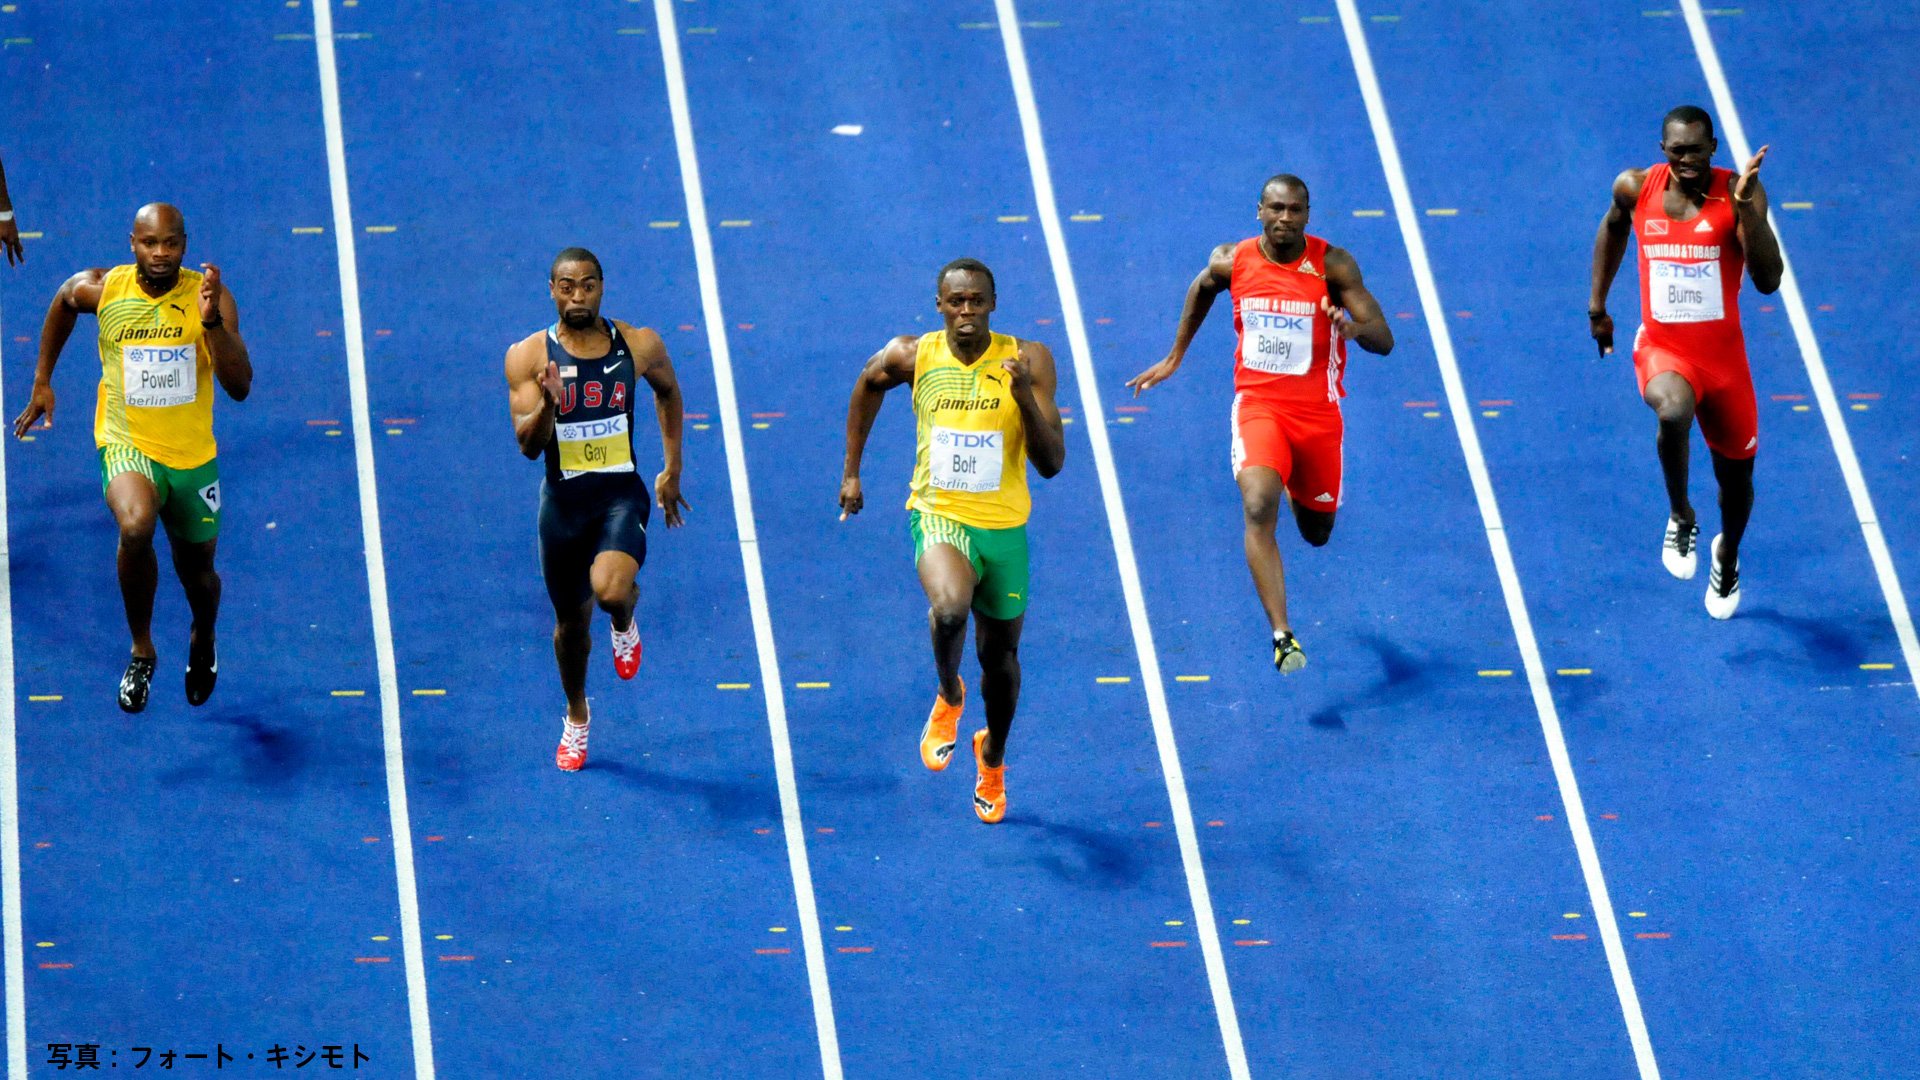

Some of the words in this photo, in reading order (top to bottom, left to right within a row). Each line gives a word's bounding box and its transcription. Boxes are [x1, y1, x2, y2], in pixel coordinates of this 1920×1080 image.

[1669, 264, 1713, 279] TDK
[1668, 284, 1703, 304] Burns
[1258, 314, 1304, 330] TDK
[115, 324, 183, 343] jamaica
[143, 347, 190, 363] TDK
[1257, 334, 1292, 360] Bailey
[141, 368, 181, 389] Powell
[127, 395, 167, 406] berlin
[560, 381, 625, 415] USA
[931, 394, 1001, 413] jamaica
[576, 418, 622, 438] TDK
[950, 432, 995, 449] TDK
[584, 442, 608, 465] Gay
[952, 454, 977, 475] Bolt
[932, 475, 969, 490] berlin
